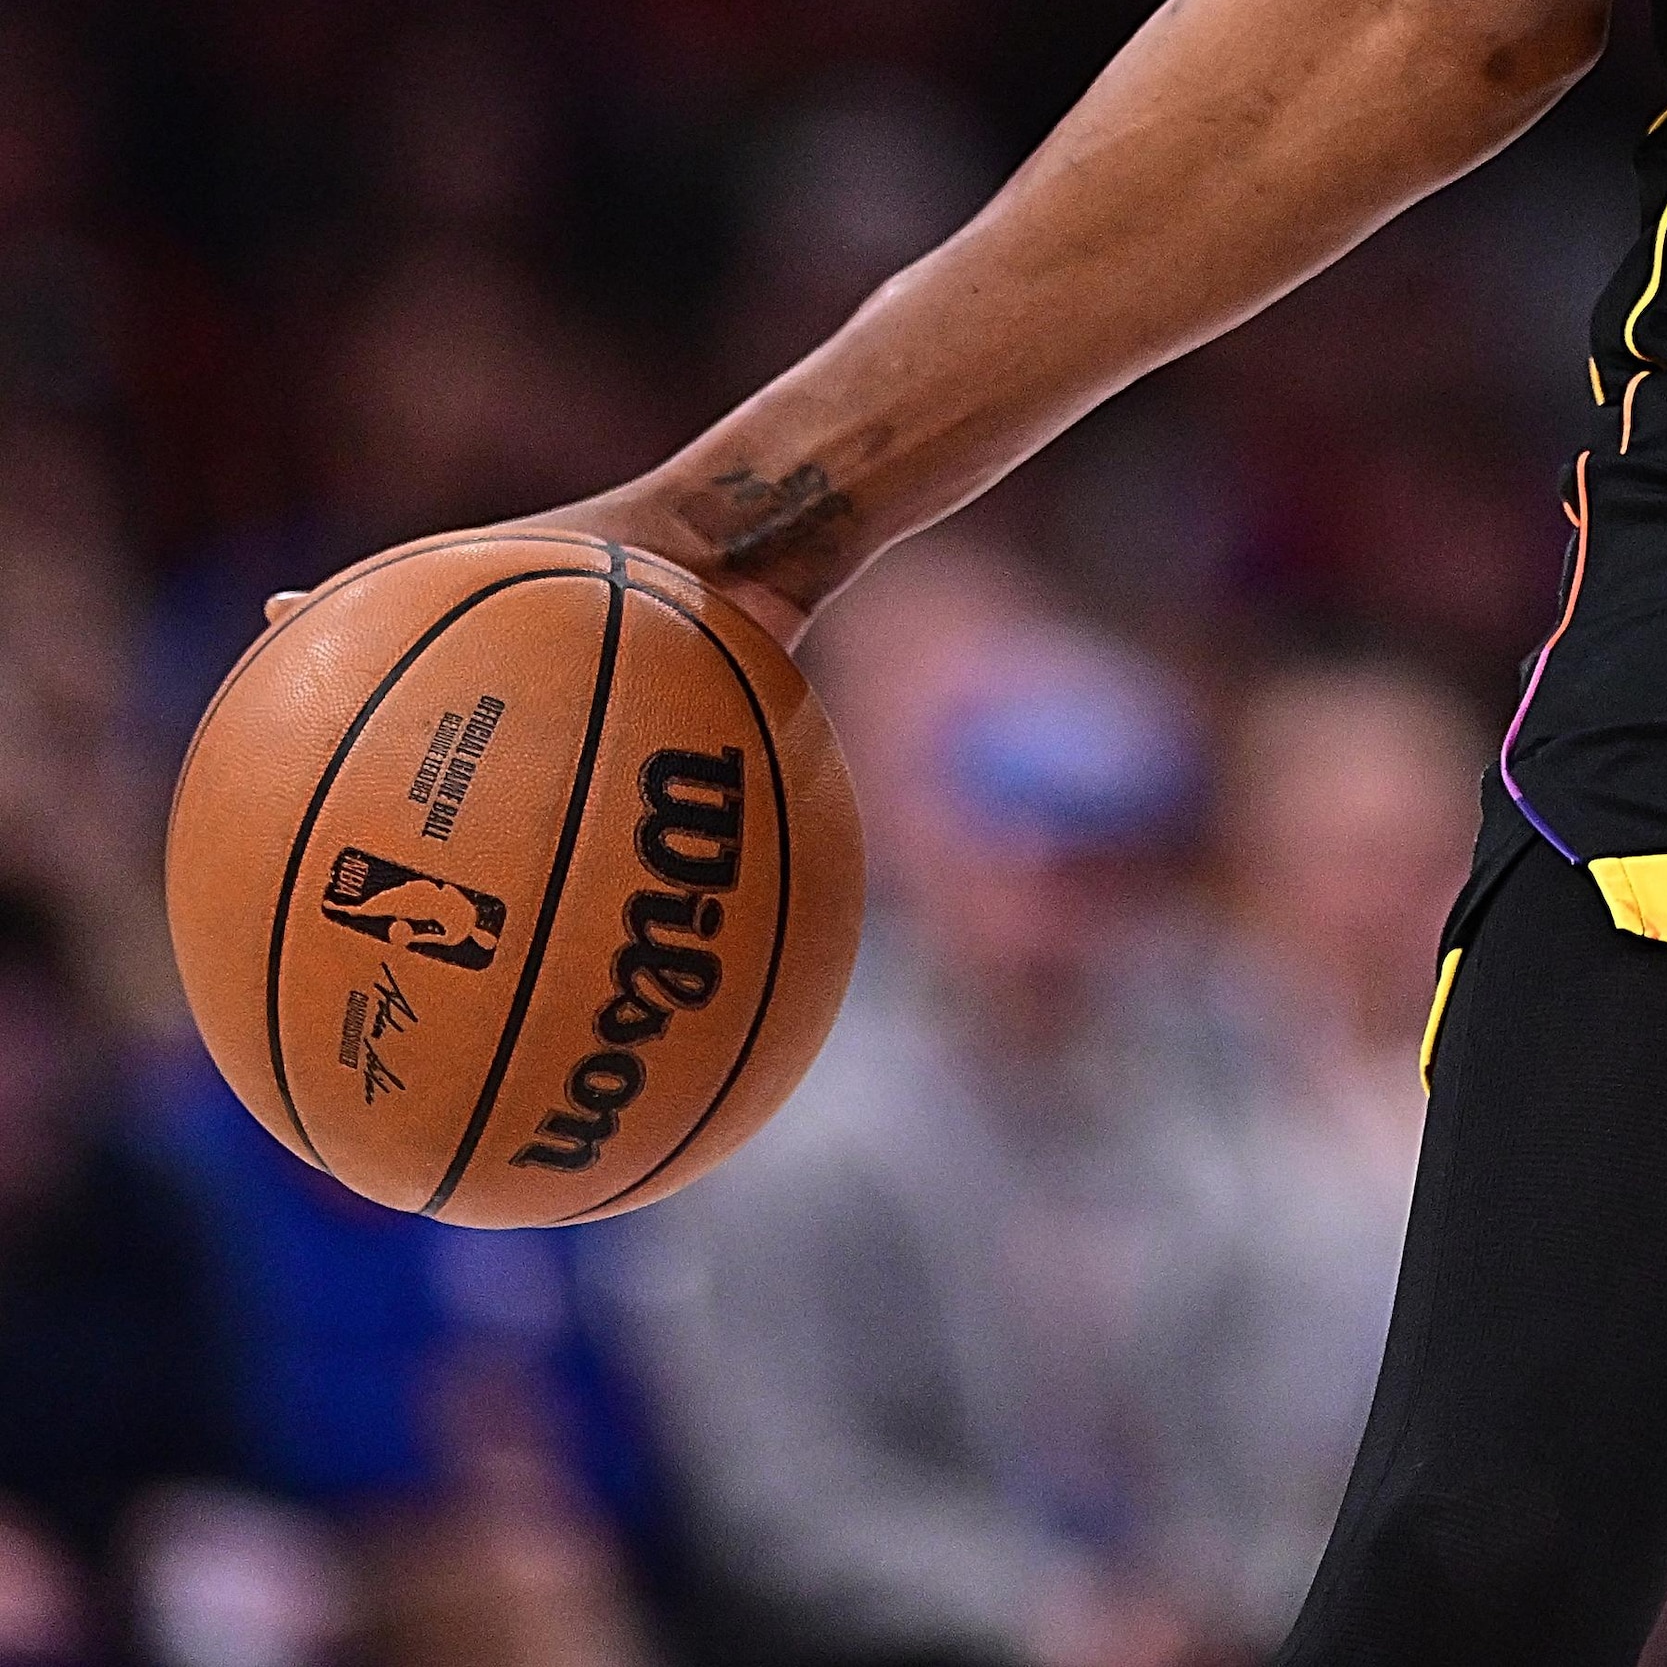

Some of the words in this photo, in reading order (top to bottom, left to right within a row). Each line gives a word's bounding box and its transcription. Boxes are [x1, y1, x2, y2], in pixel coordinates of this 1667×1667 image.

[456, 695, 506, 759] OFFICIAL
[438, 757, 477, 805] GAME
[421, 801, 458, 842] BALL
[333, 855, 369, 898] NBA
[509, 745, 744, 1172] Wilson
